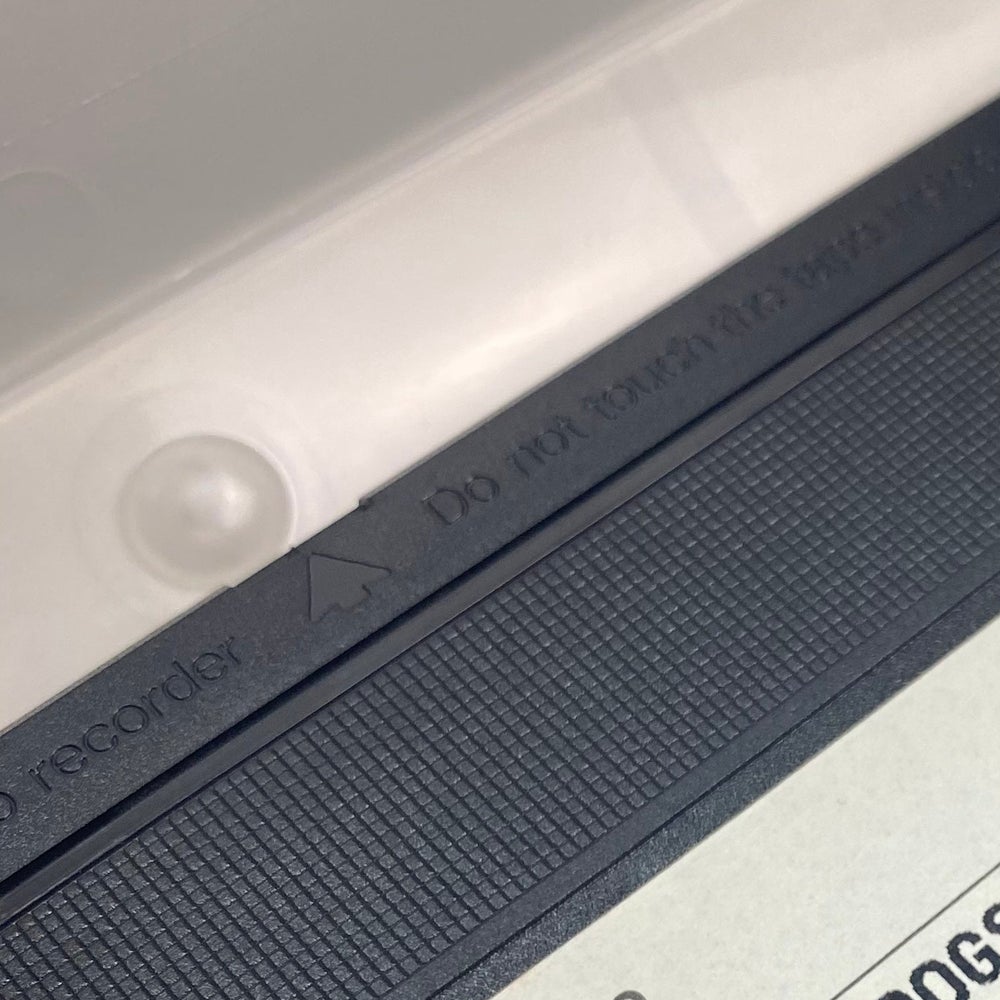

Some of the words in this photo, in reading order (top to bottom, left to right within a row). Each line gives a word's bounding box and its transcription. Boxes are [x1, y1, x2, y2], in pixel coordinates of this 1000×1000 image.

[422, 474, 500, 527] Do
[506, 414, 589, 482] not
[581, 332, 715, 423] touch
[28, 636, 241, 791] recorder
